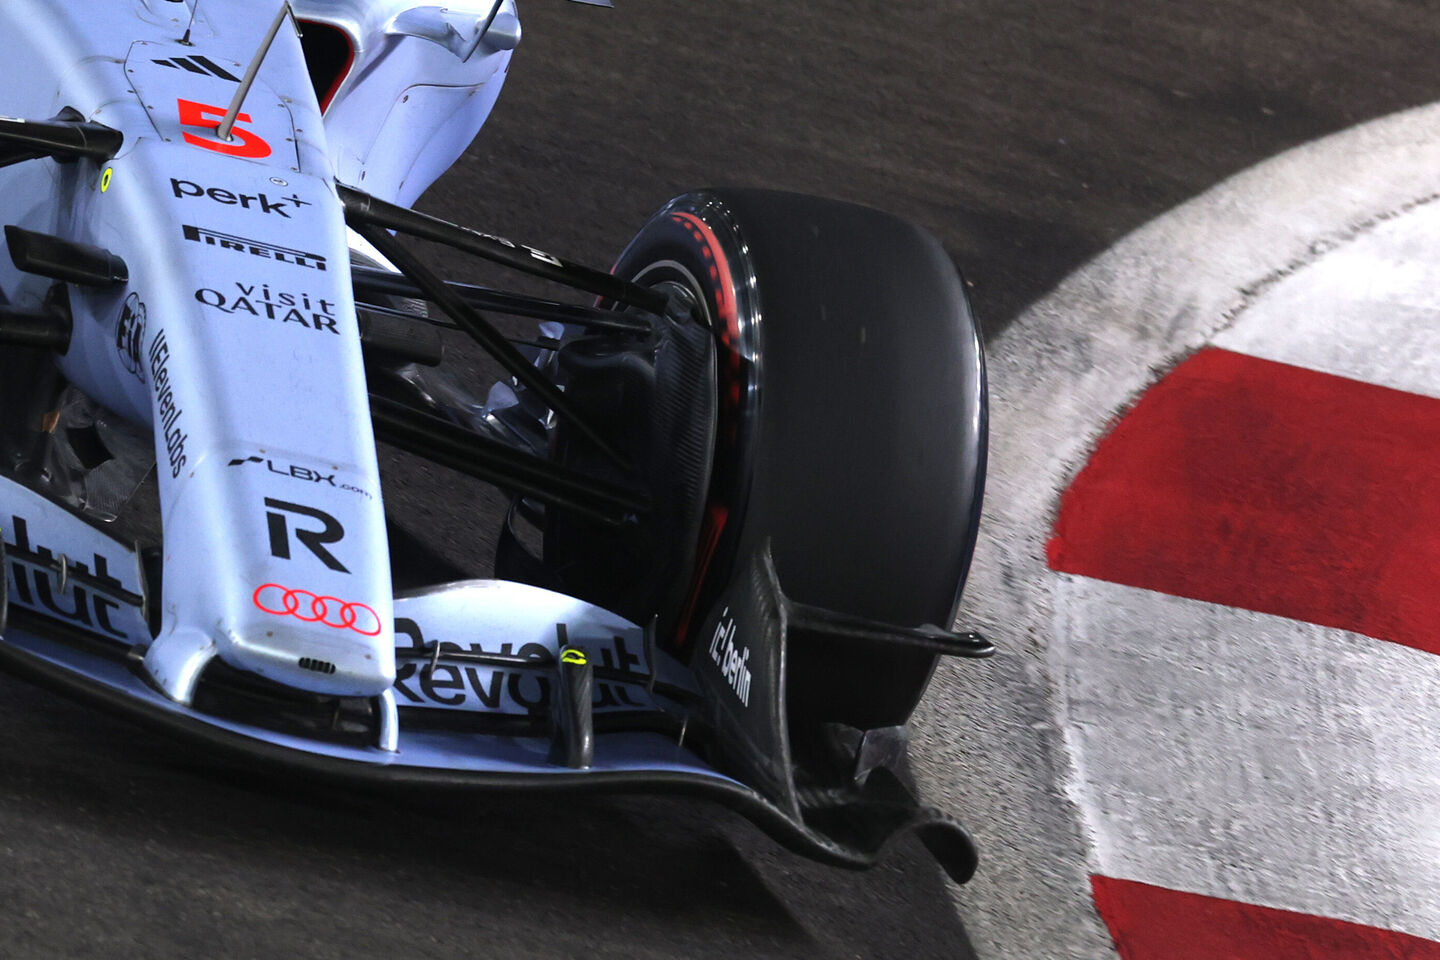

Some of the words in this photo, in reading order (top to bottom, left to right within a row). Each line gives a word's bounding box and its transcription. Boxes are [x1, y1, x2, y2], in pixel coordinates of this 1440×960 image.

[177, 98, 272, 158] 5
[182, 224, 327, 271] PIRELLI
[194, 288, 342, 335] QATAR
[236, 282, 336, 316] visit
[264, 496, 353, 575] R
[709, 606, 734, 667] ic!
[721, 625, 752, 708] berlin
